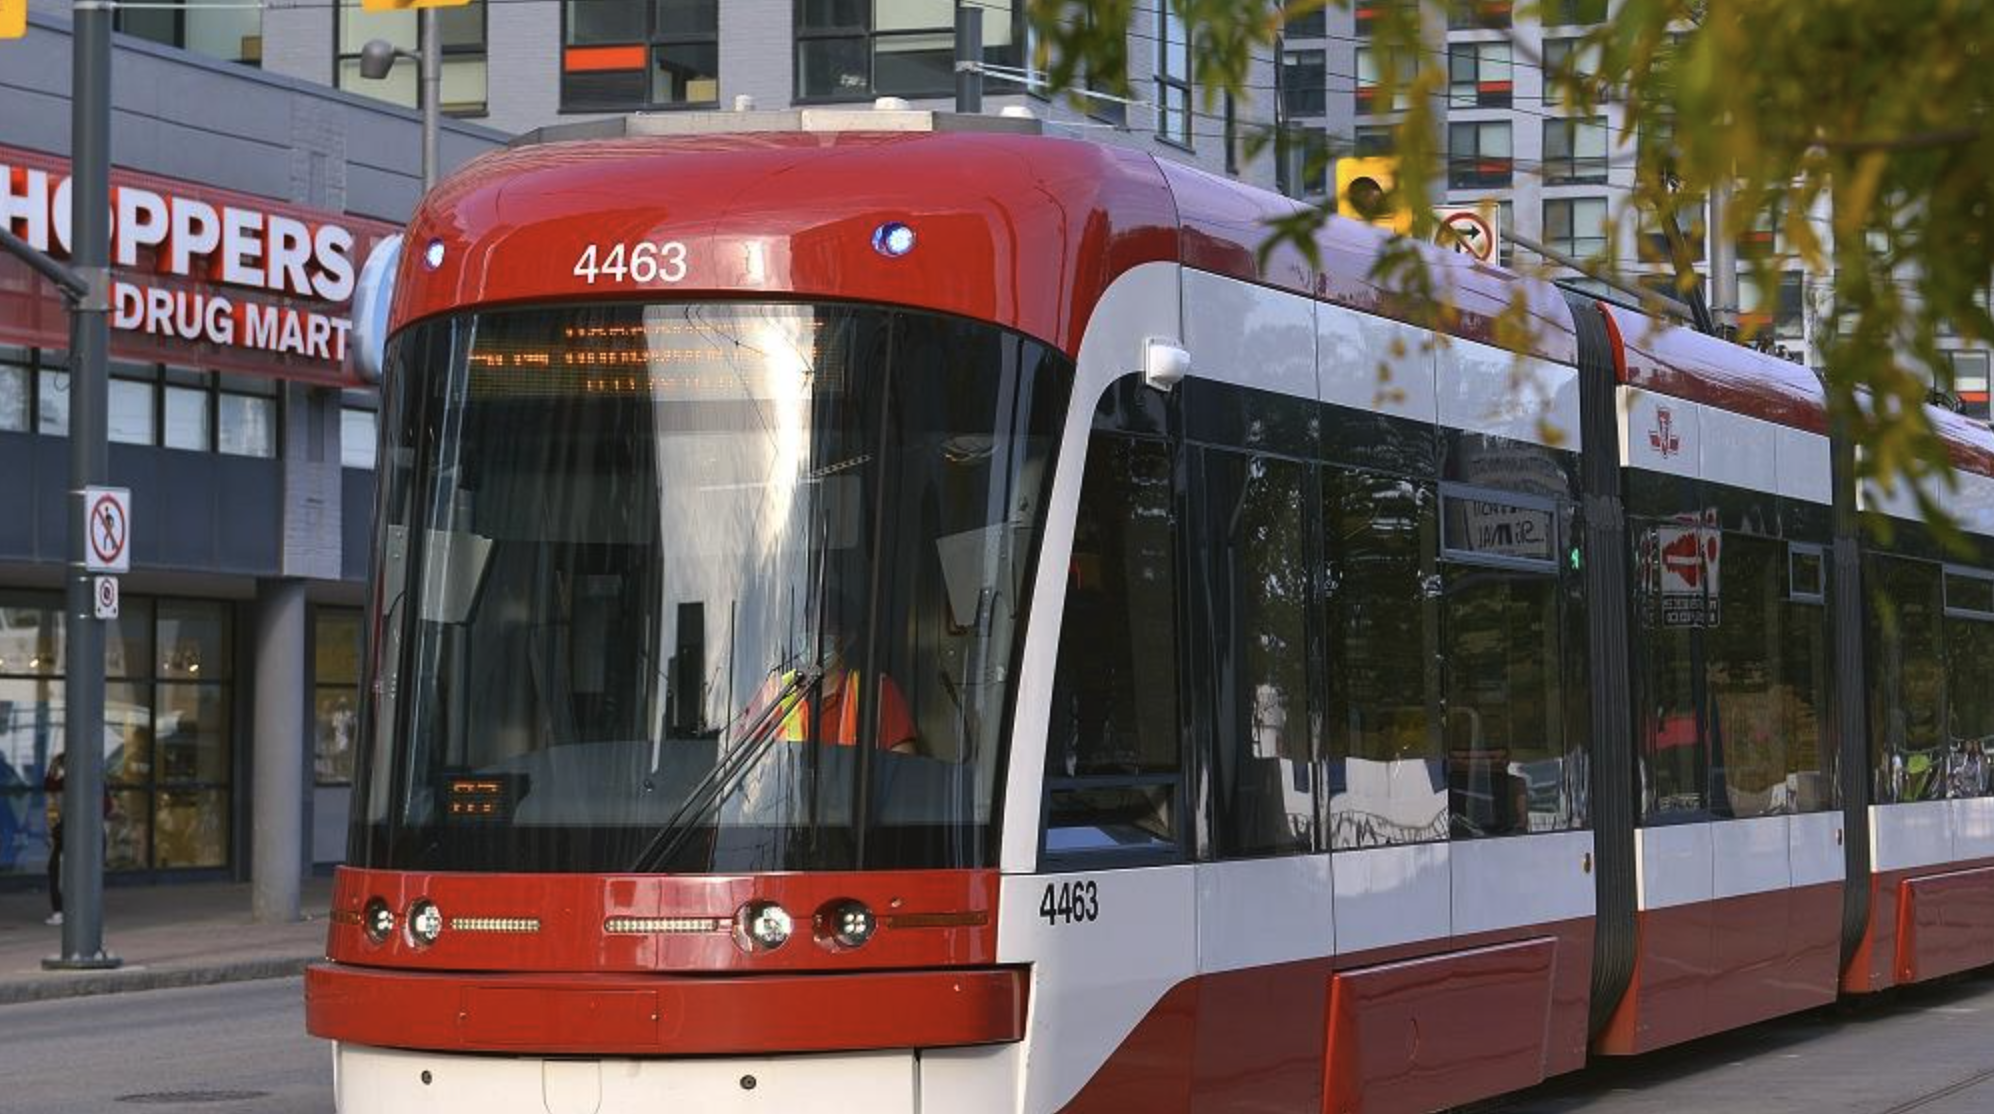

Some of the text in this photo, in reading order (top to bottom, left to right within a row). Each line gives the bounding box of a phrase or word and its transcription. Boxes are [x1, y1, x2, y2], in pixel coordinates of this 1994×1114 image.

[573, 241, 687, 284] 4463
[114, 281, 353, 361] DRUG MART
[1039, 880, 1099, 926] 4463
